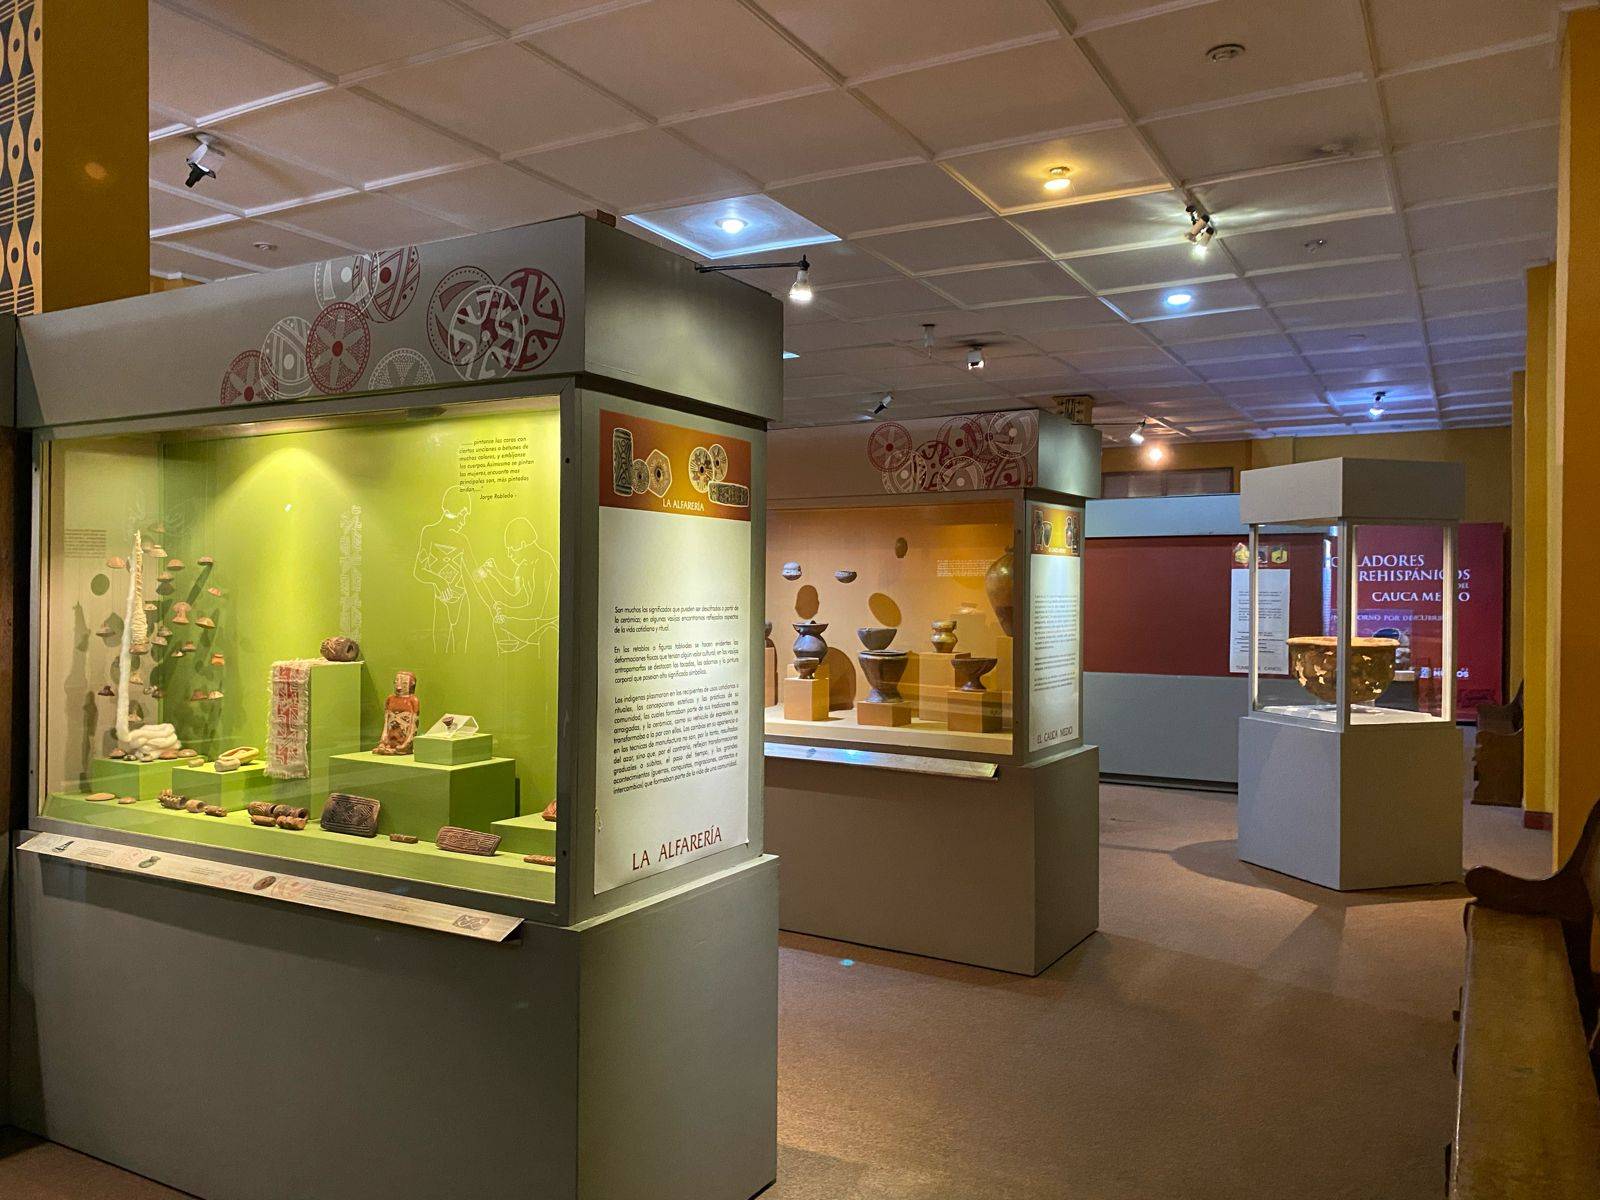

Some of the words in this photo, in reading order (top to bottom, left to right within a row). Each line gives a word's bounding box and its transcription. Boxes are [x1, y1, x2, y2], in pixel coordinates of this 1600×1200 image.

[663, 499, 671, 508] LA
[1372, 592, 1418, 602] CAUCA
[1422, 592, 1470, 602] MEO
[632, 850, 650, 870] LA
[658, 825, 722, 862] ALFARERÍA
